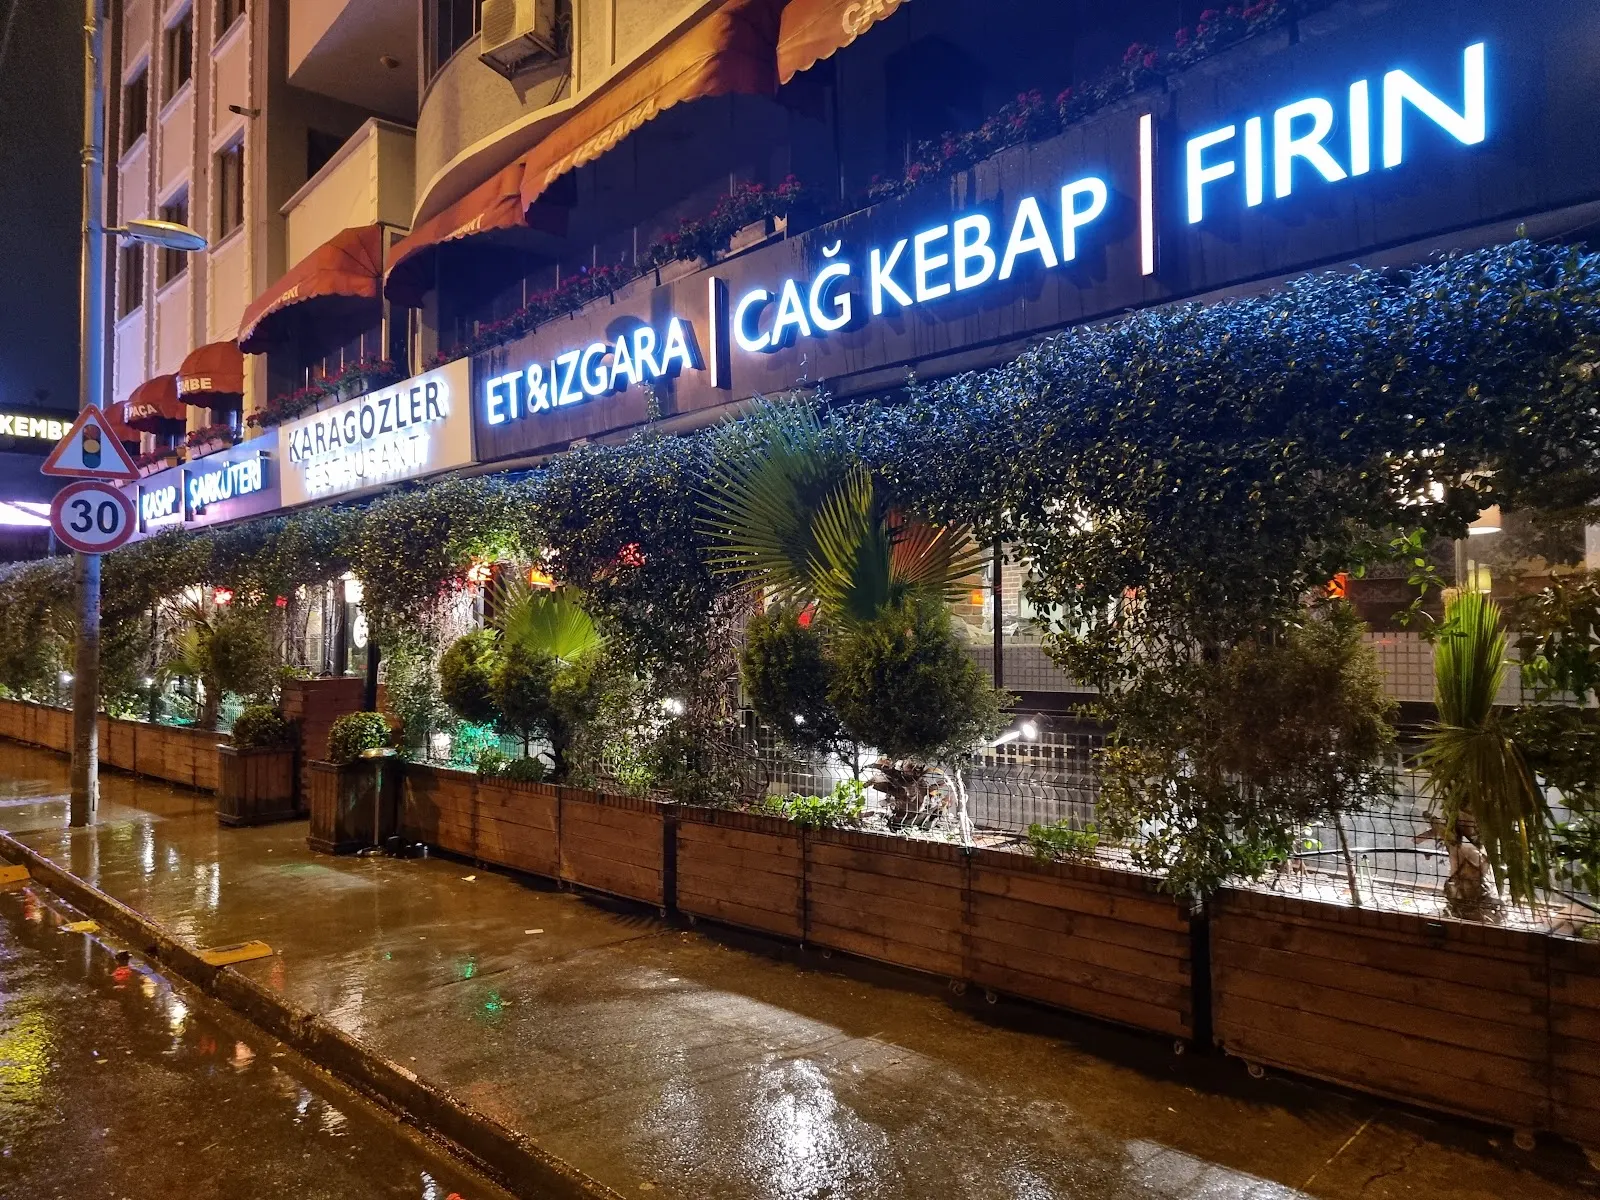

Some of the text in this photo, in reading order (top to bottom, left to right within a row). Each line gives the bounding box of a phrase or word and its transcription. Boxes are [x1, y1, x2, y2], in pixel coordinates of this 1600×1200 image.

[1187, 42, 1485, 224] FIRIN
[870, 176, 1108, 316] KEBAP
[486, 316, 693, 425] ET&IZGARA
[288, 381, 441, 463] KARAGÖZLER
[70, 499, 119, 534] 30
[142, 485, 176, 520] KASAP
